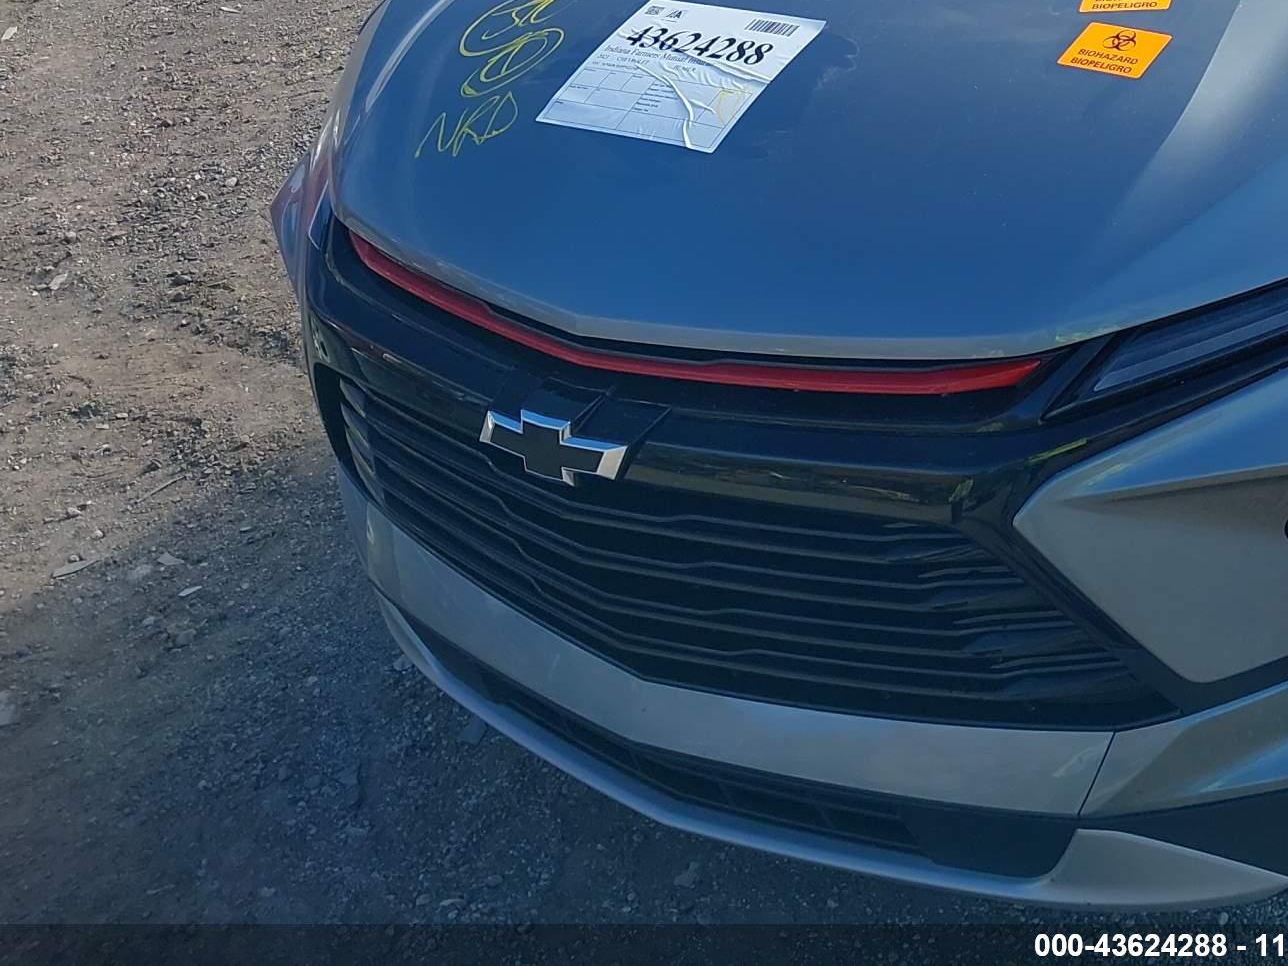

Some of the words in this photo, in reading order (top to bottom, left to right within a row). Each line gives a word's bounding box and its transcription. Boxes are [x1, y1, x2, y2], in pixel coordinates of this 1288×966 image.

[1091, 1, 1158, 10] BIOPELIGRO
[626, 25, 774, 65] 43624288
[630, 47, 660, 59] Farmers
[659, 52, 687, 63] Mutual
[1077, 48, 1138, 65] BIOHAZARD
[1070, 56, 1132, 74] BIOPELIGRO
